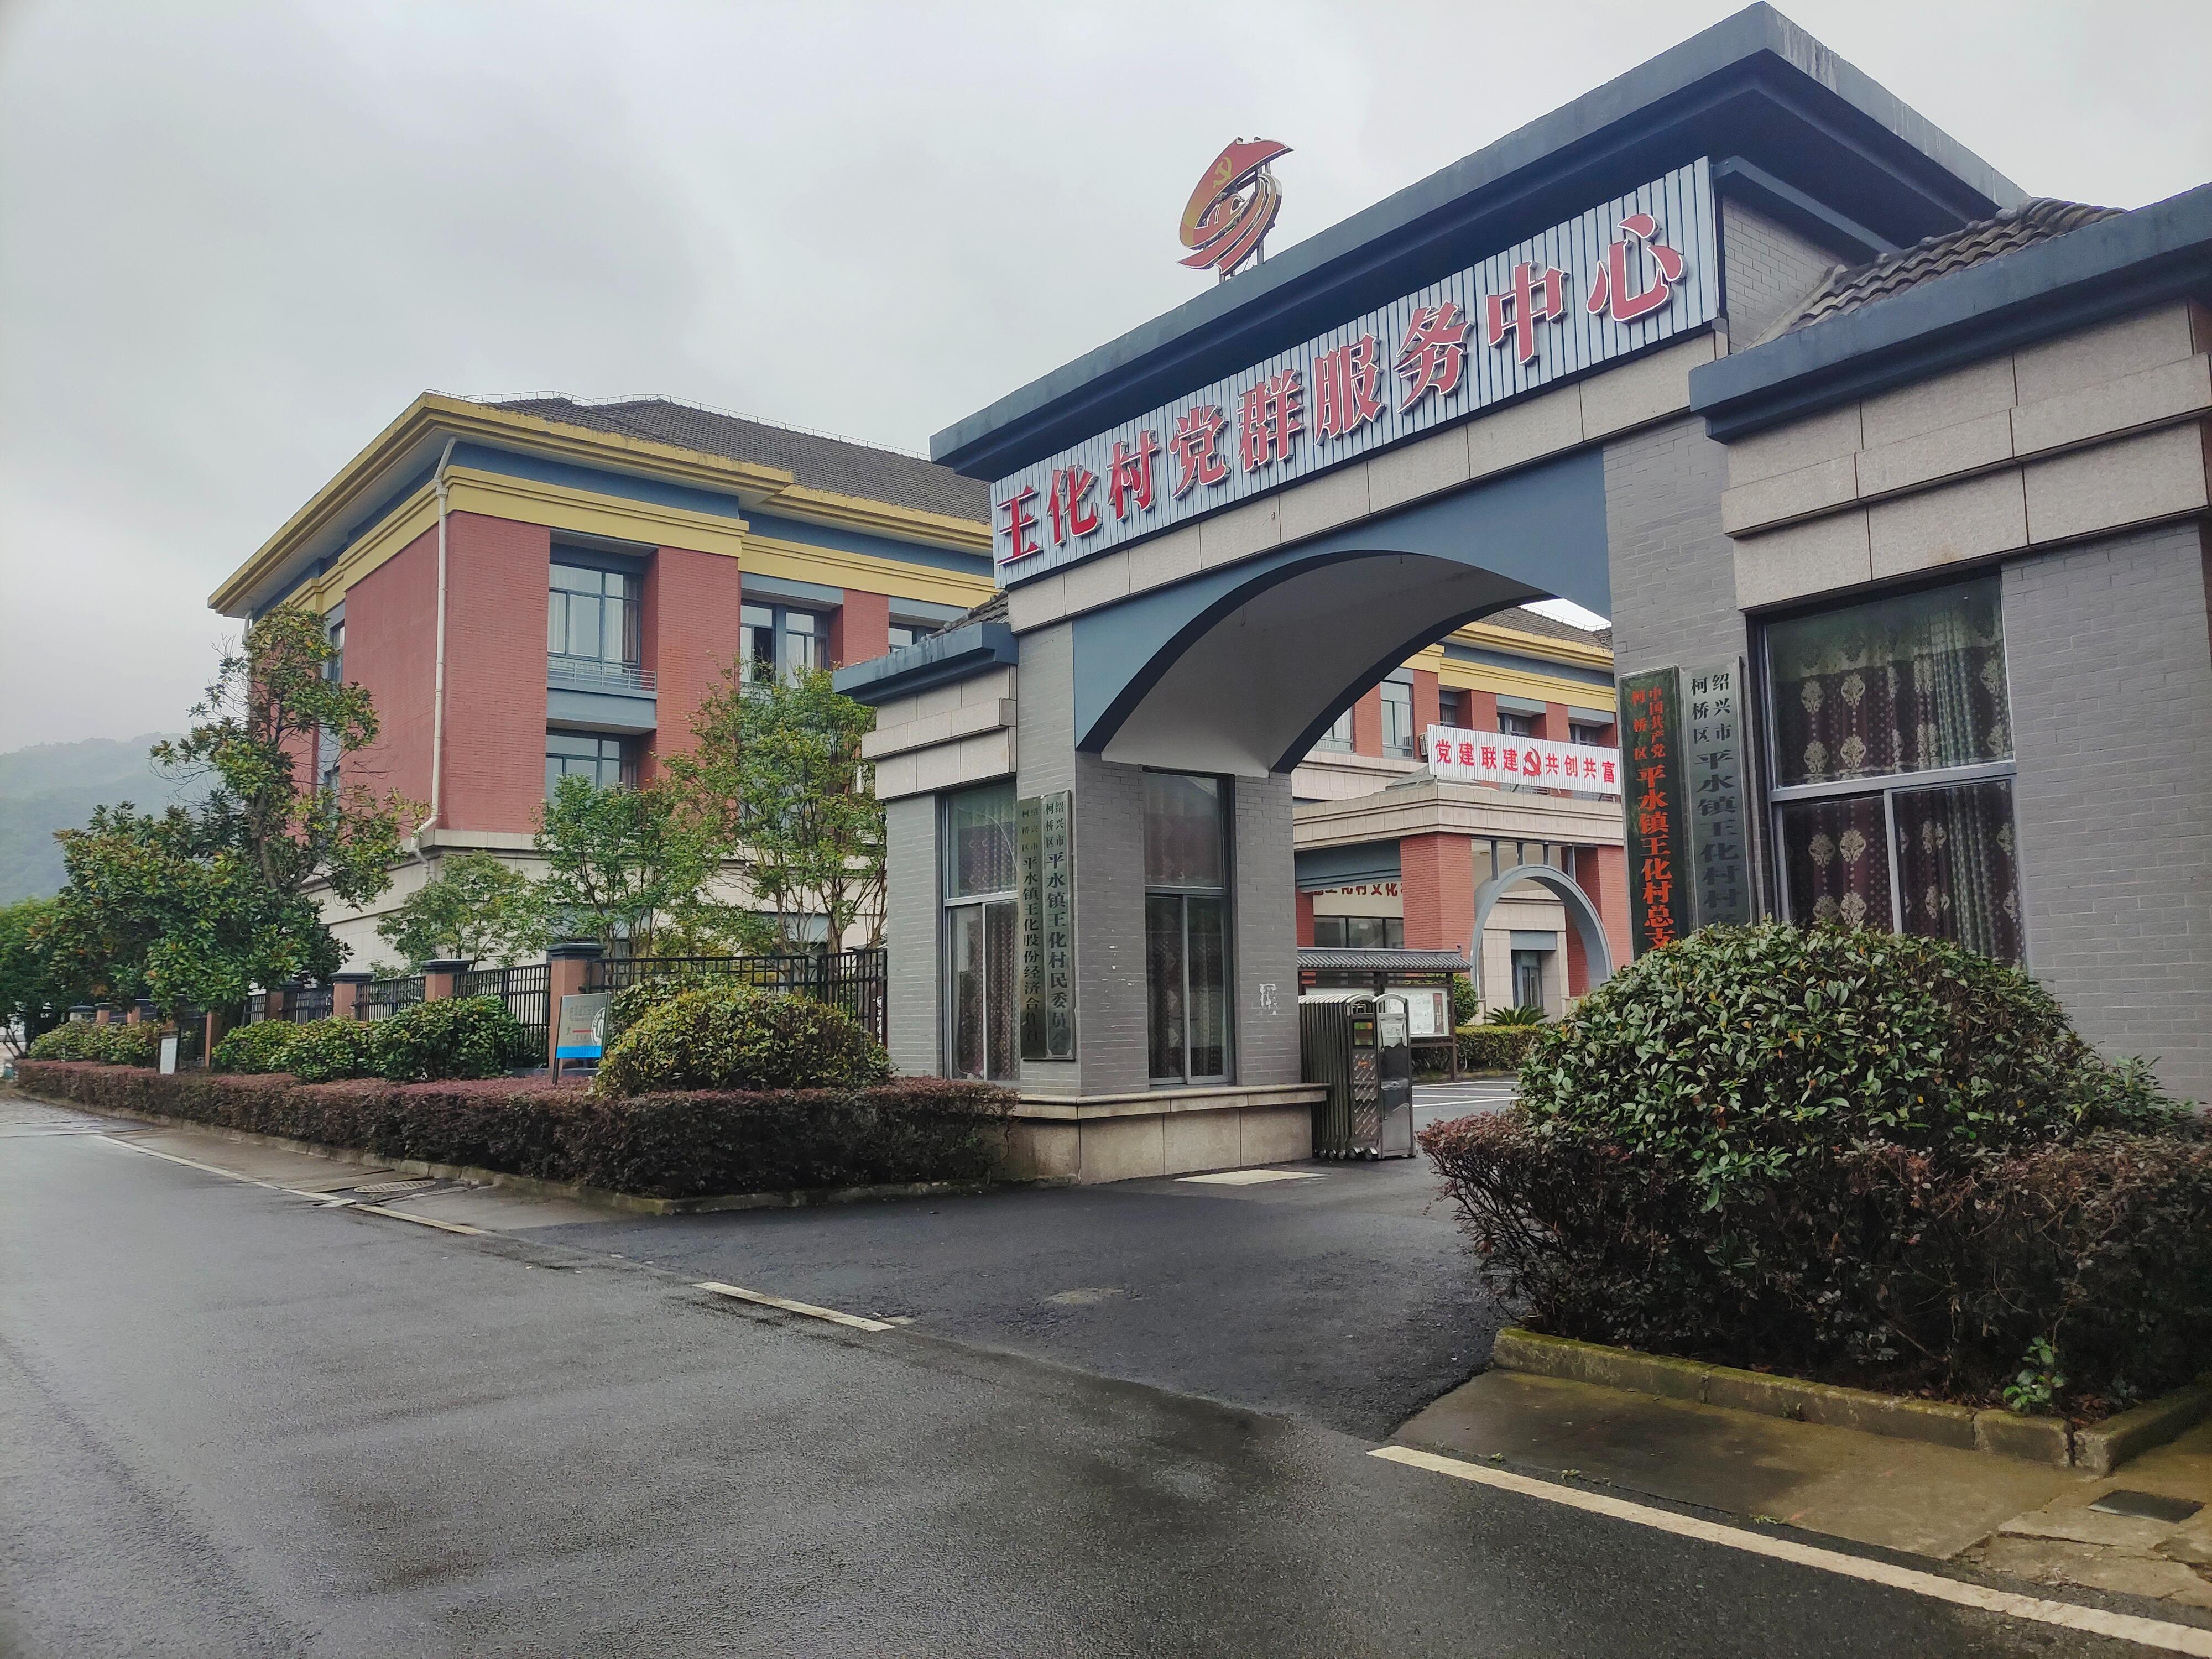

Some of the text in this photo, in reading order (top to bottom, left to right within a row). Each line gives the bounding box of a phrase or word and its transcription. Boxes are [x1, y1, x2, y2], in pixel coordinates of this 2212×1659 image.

[997, 213, 1687, 566] 王化村党群服务中心
[1632, 690, 1648, 761] 柯桥区
[1648, 686, 1666, 758] 中国共产党
[1690, 676, 1710, 744] 柯桥区
[1712, 673, 1731, 741] 绍兴市
[1435, 739, 1615, 784] 党建联建 共创共富
